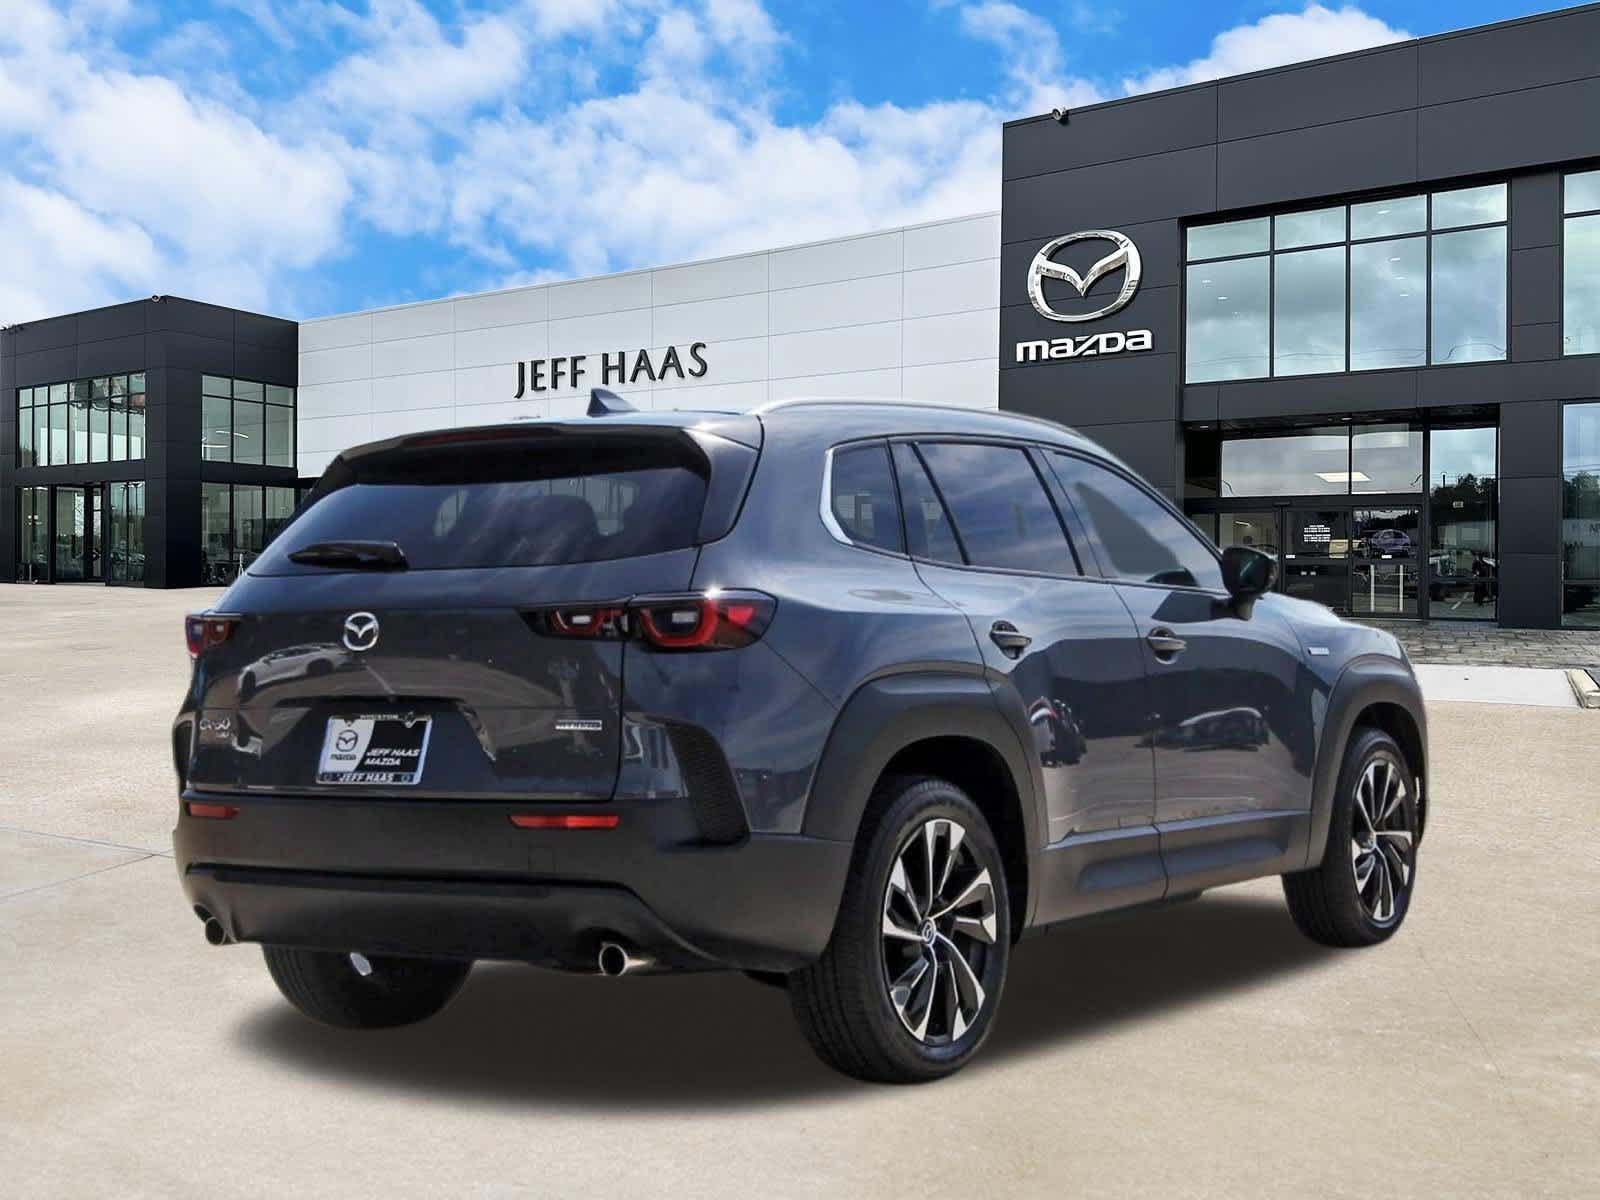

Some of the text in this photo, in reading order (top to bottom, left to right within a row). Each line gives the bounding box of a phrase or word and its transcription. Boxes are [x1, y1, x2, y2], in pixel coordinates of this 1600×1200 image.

[514, 342, 708, 399] JEFF HAAS
[366, 748, 420, 757] JEFF HAAS
[364, 758, 401, 766] MAZDA
[339, 773, 394, 781] JEFF HAAS
